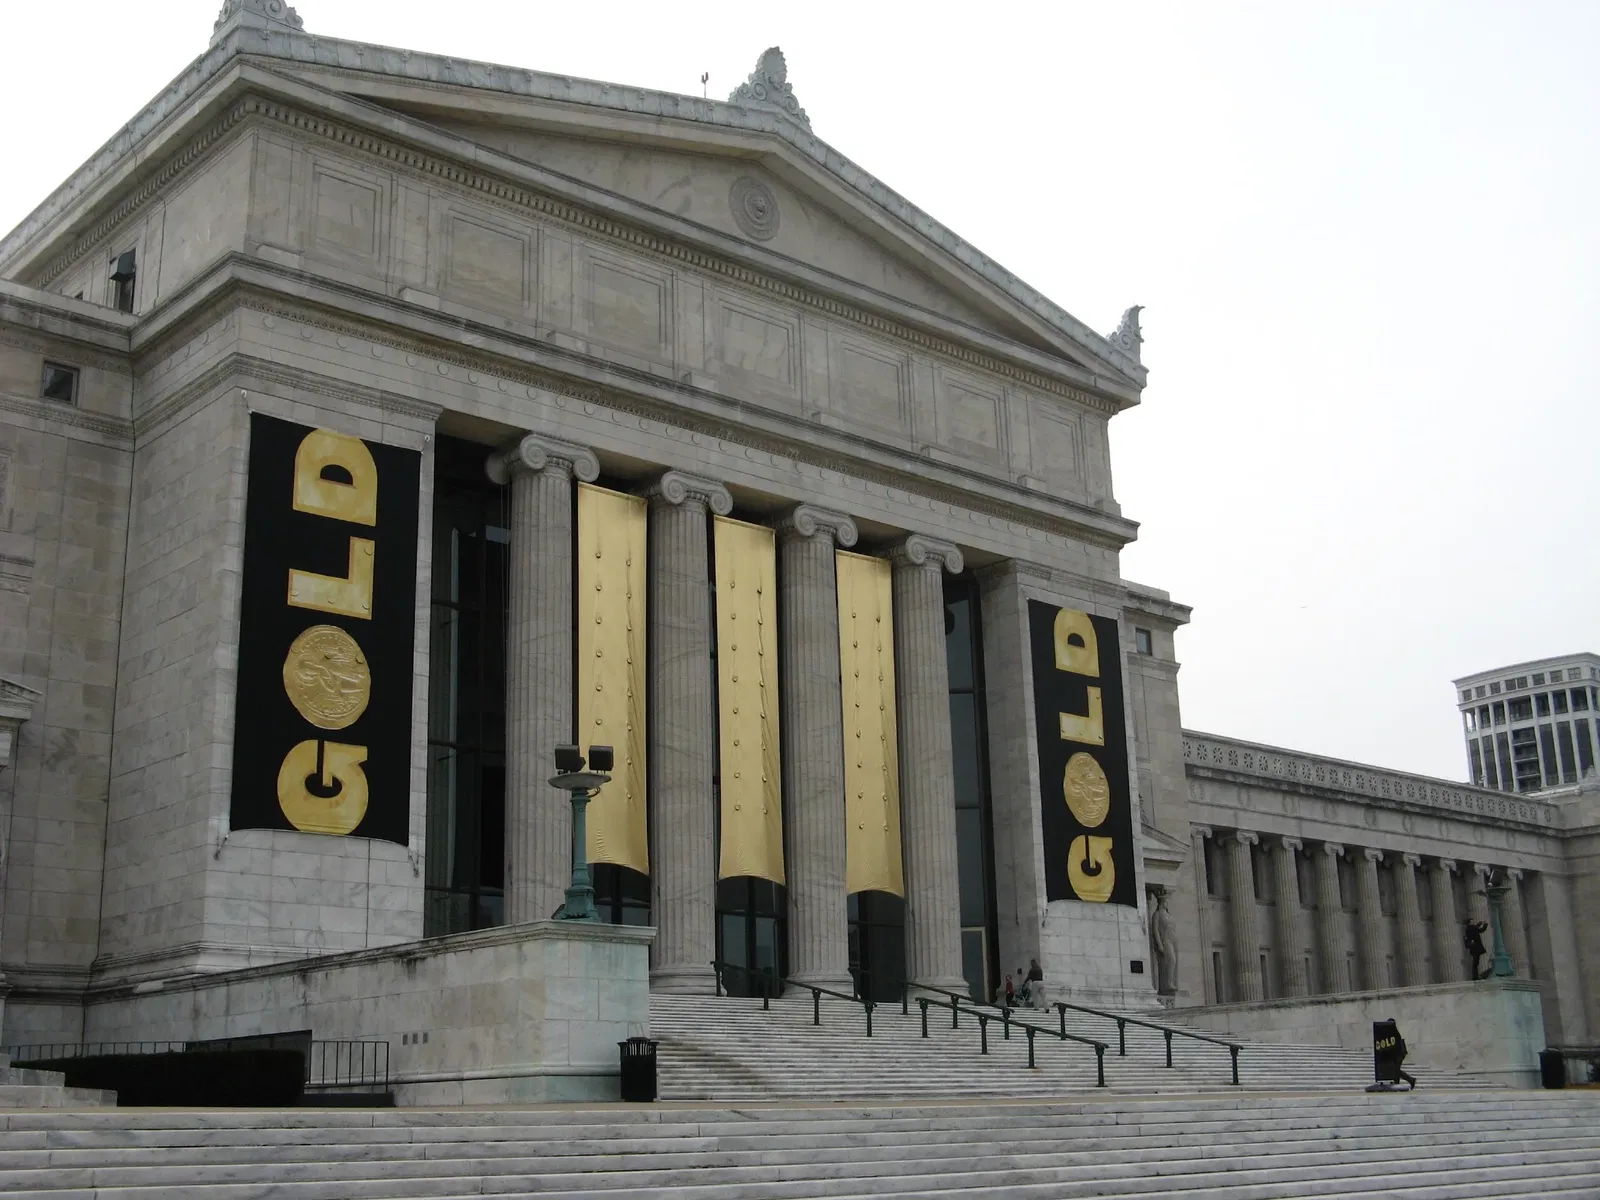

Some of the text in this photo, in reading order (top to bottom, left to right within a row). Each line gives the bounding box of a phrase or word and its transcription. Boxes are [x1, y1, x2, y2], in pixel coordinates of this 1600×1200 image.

[277, 428, 378, 835] GOLD
[1054, 607, 1115, 903] GOLD
[1376, 1036, 1396, 1050] GOLD
